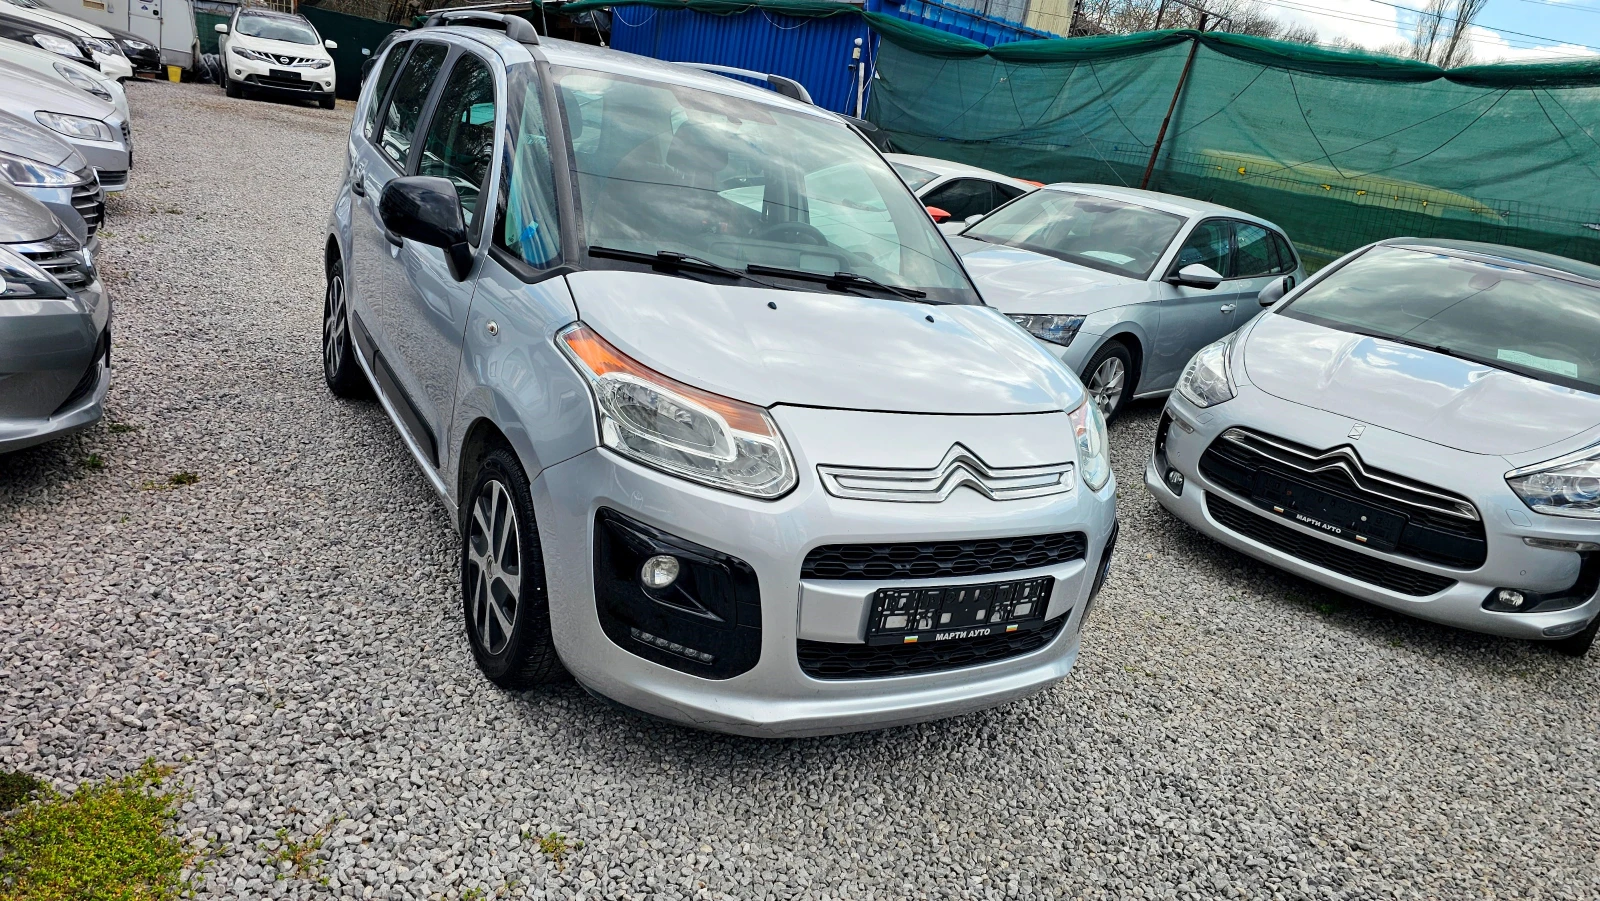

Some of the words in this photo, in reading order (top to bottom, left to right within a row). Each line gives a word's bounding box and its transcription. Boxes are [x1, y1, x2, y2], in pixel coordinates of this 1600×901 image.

[1296, 513, 1321, 527] МАРТИ
[1321, 523, 1342, 534] АУТО
[935, 630, 967, 641] МАРТИ
[967, 628, 991, 638] АУТО
